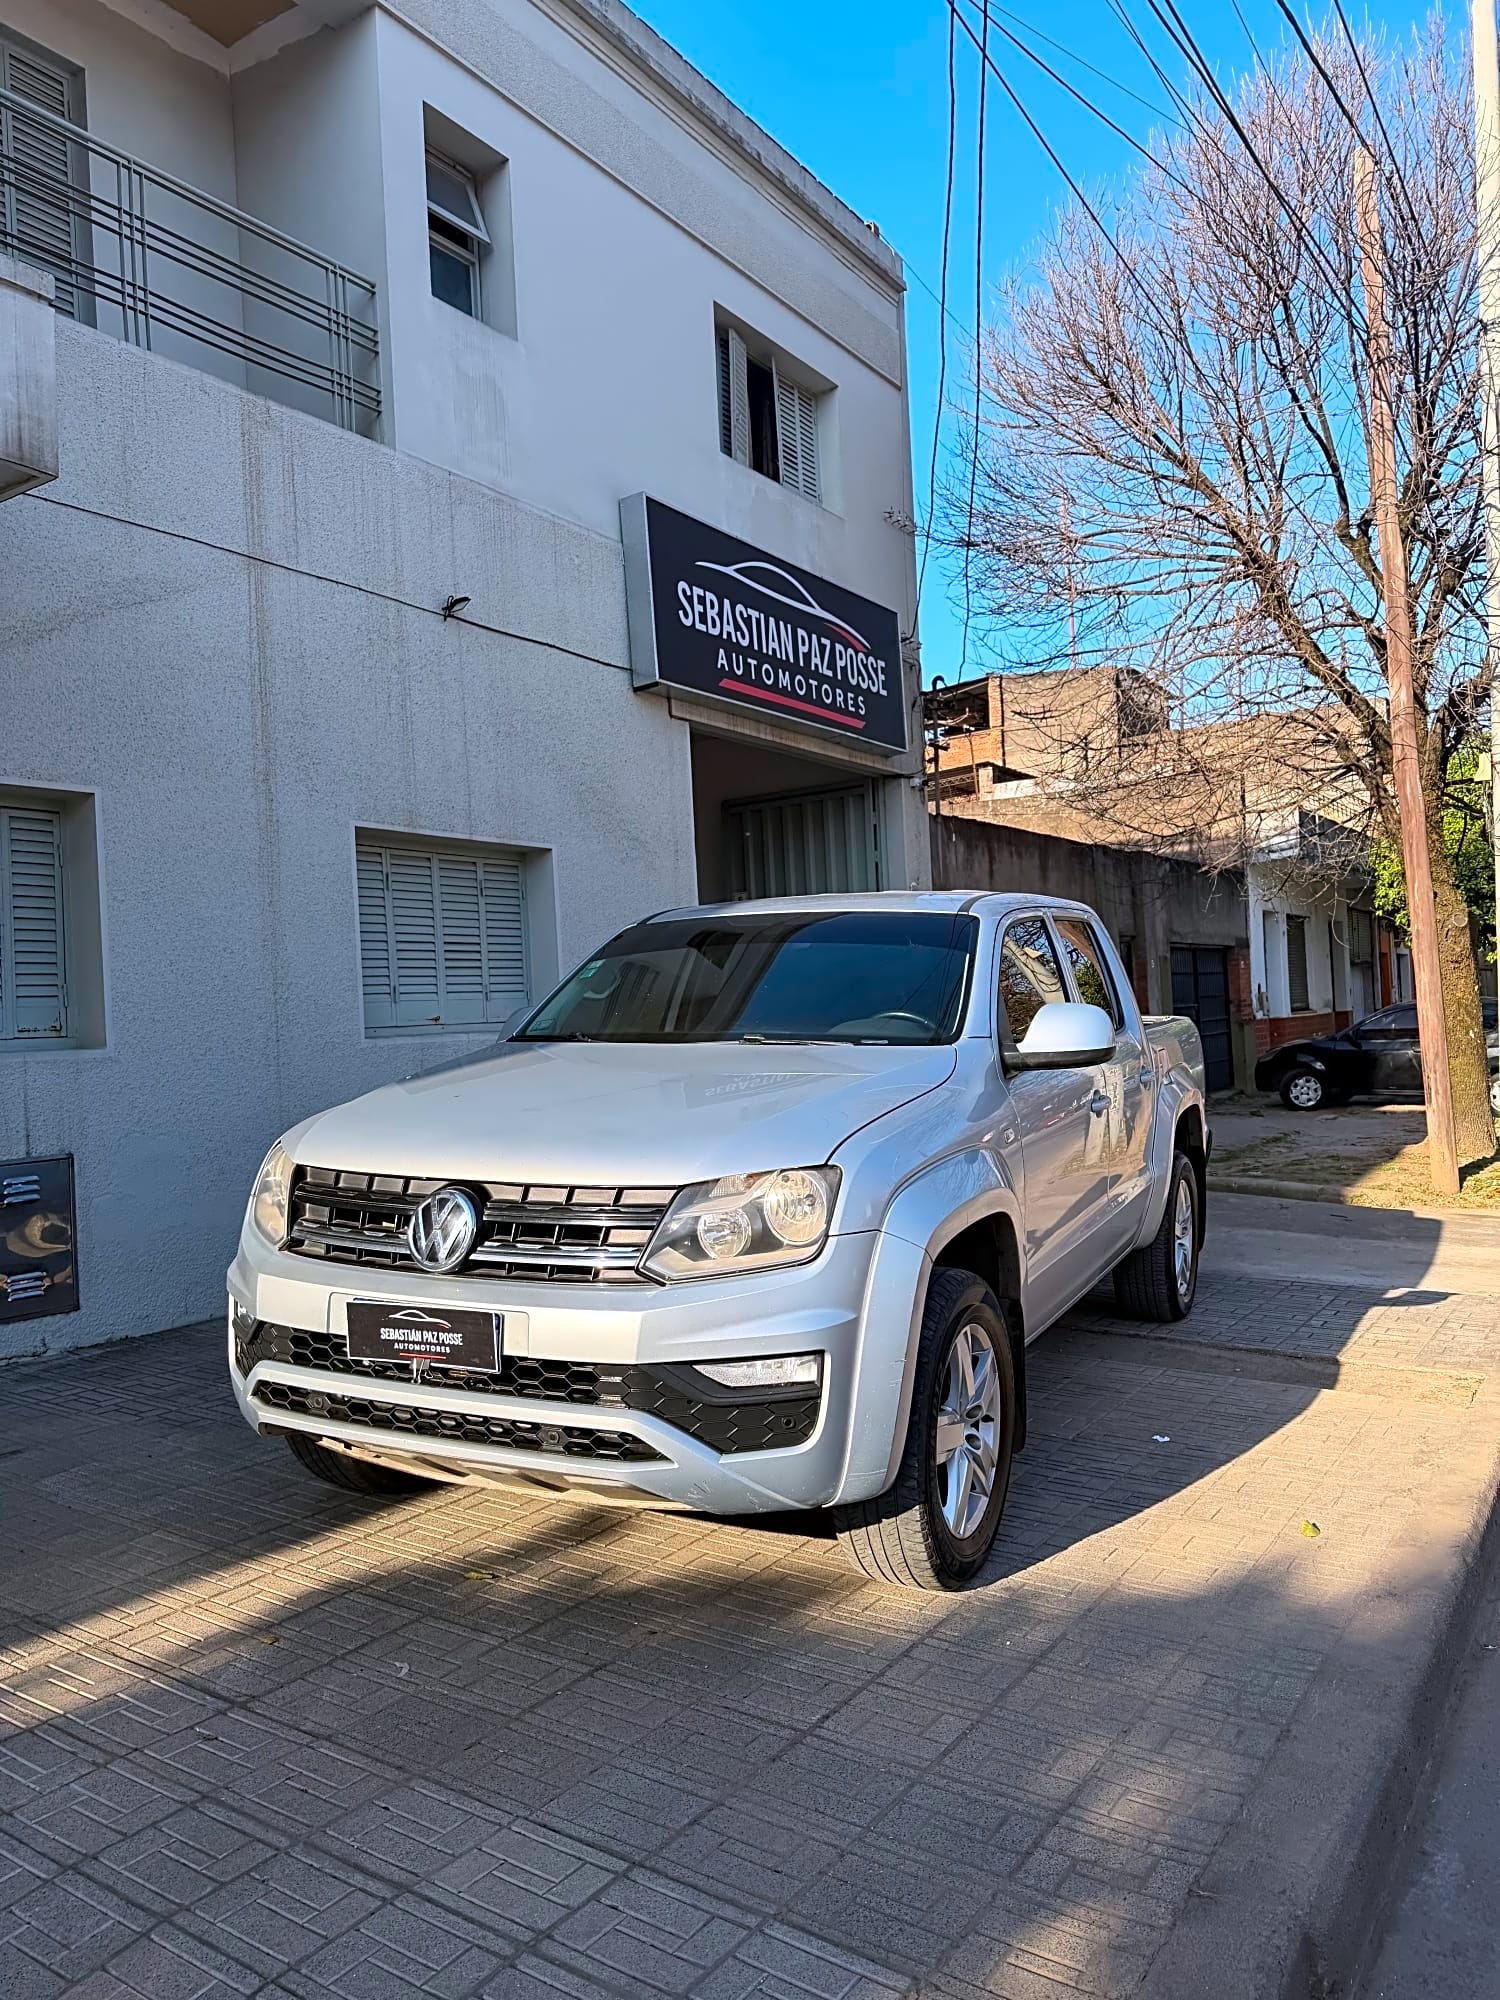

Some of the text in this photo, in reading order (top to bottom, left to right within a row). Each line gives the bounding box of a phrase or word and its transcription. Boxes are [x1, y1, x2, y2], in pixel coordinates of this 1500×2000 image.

[677, 580, 888, 697] SEBASTIAN PAZ POSSE
[717, 648, 866, 716] AUTOMOTORES
[393, 1342, 450, 1353] AUTOMOTORES
[422, 1331, 438, 1343] PAZ
[439, 1332, 463, 1345] POSSE
